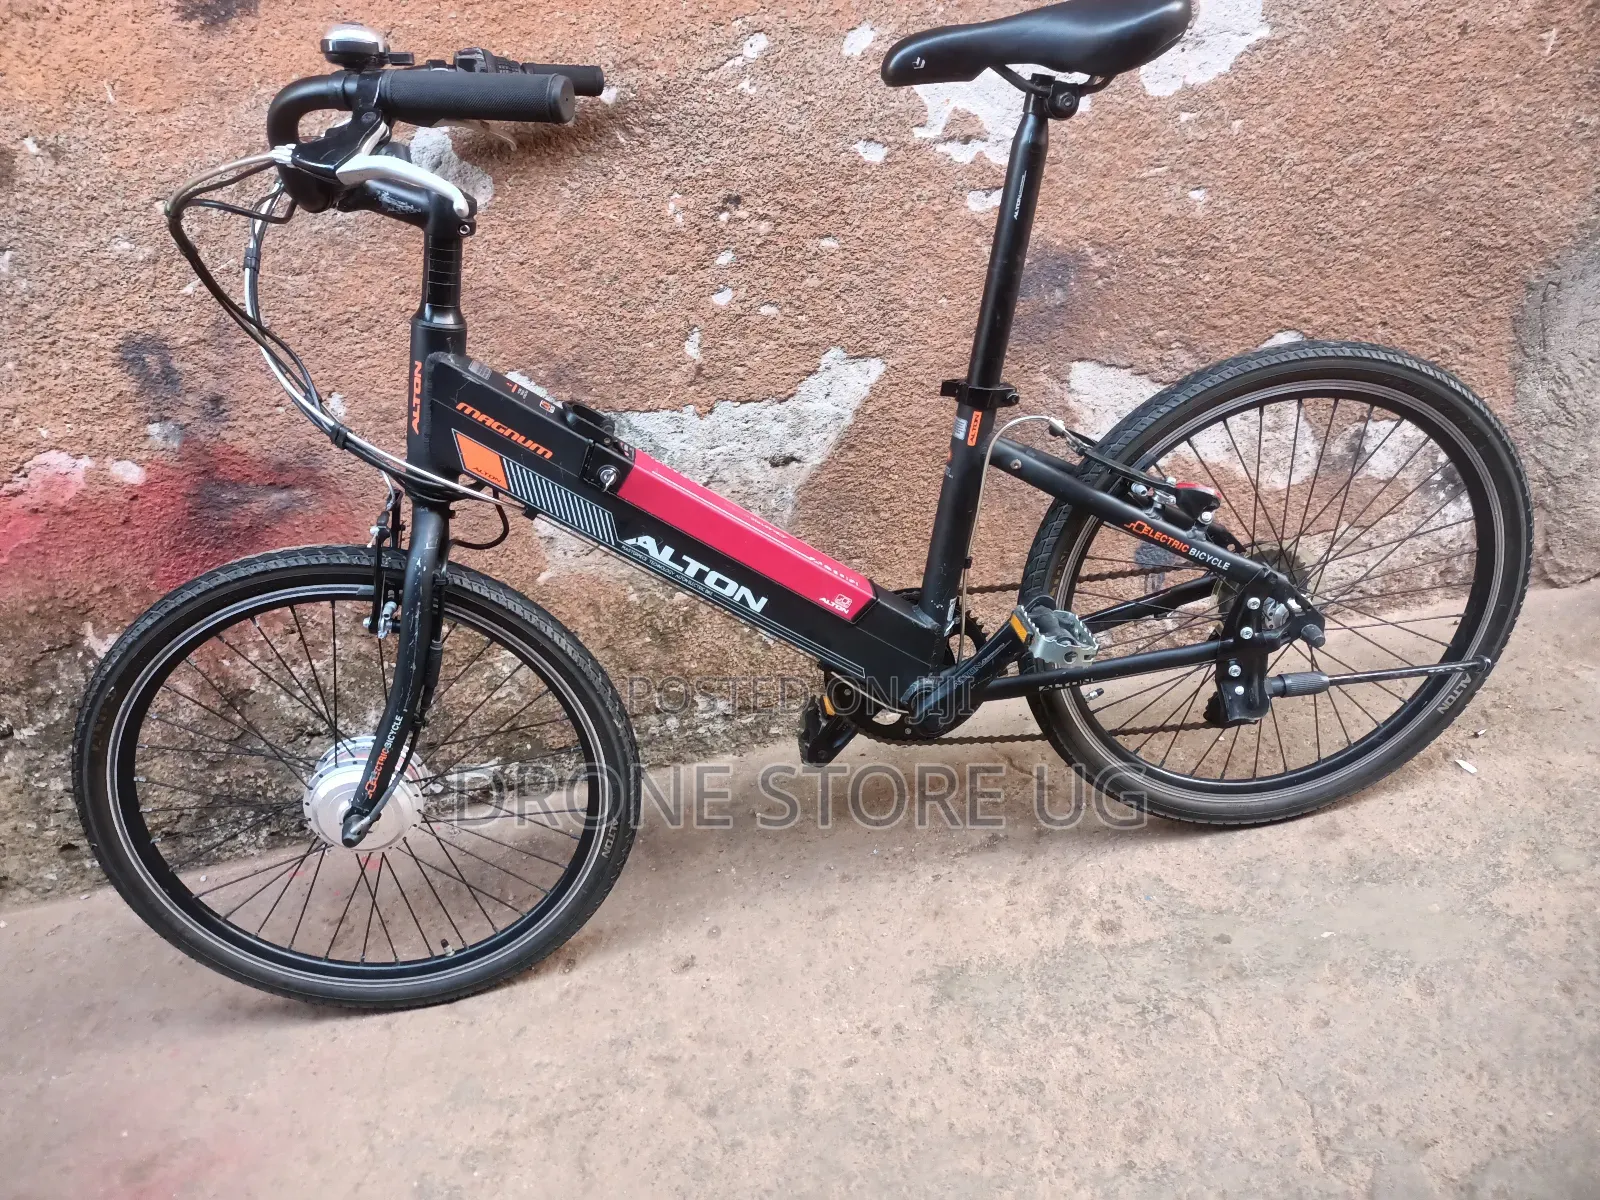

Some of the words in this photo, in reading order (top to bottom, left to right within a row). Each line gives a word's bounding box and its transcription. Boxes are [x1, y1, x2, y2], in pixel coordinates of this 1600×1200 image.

[412, 361, 422, 435] ALTON
[969, 414, 980, 443] ALTON
[473, 466, 501, 483] ALTON
[1142, 526, 1190, 553] ELECTRIC
[1188, 547, 1231, 571] BICYCLE
[623, 535, 768, 613] ALTON
[819, 597, 849, 614] ALTON
[1436, 672, 1472, 714] ALTON
[602, 817, 619, 859] ALTON
